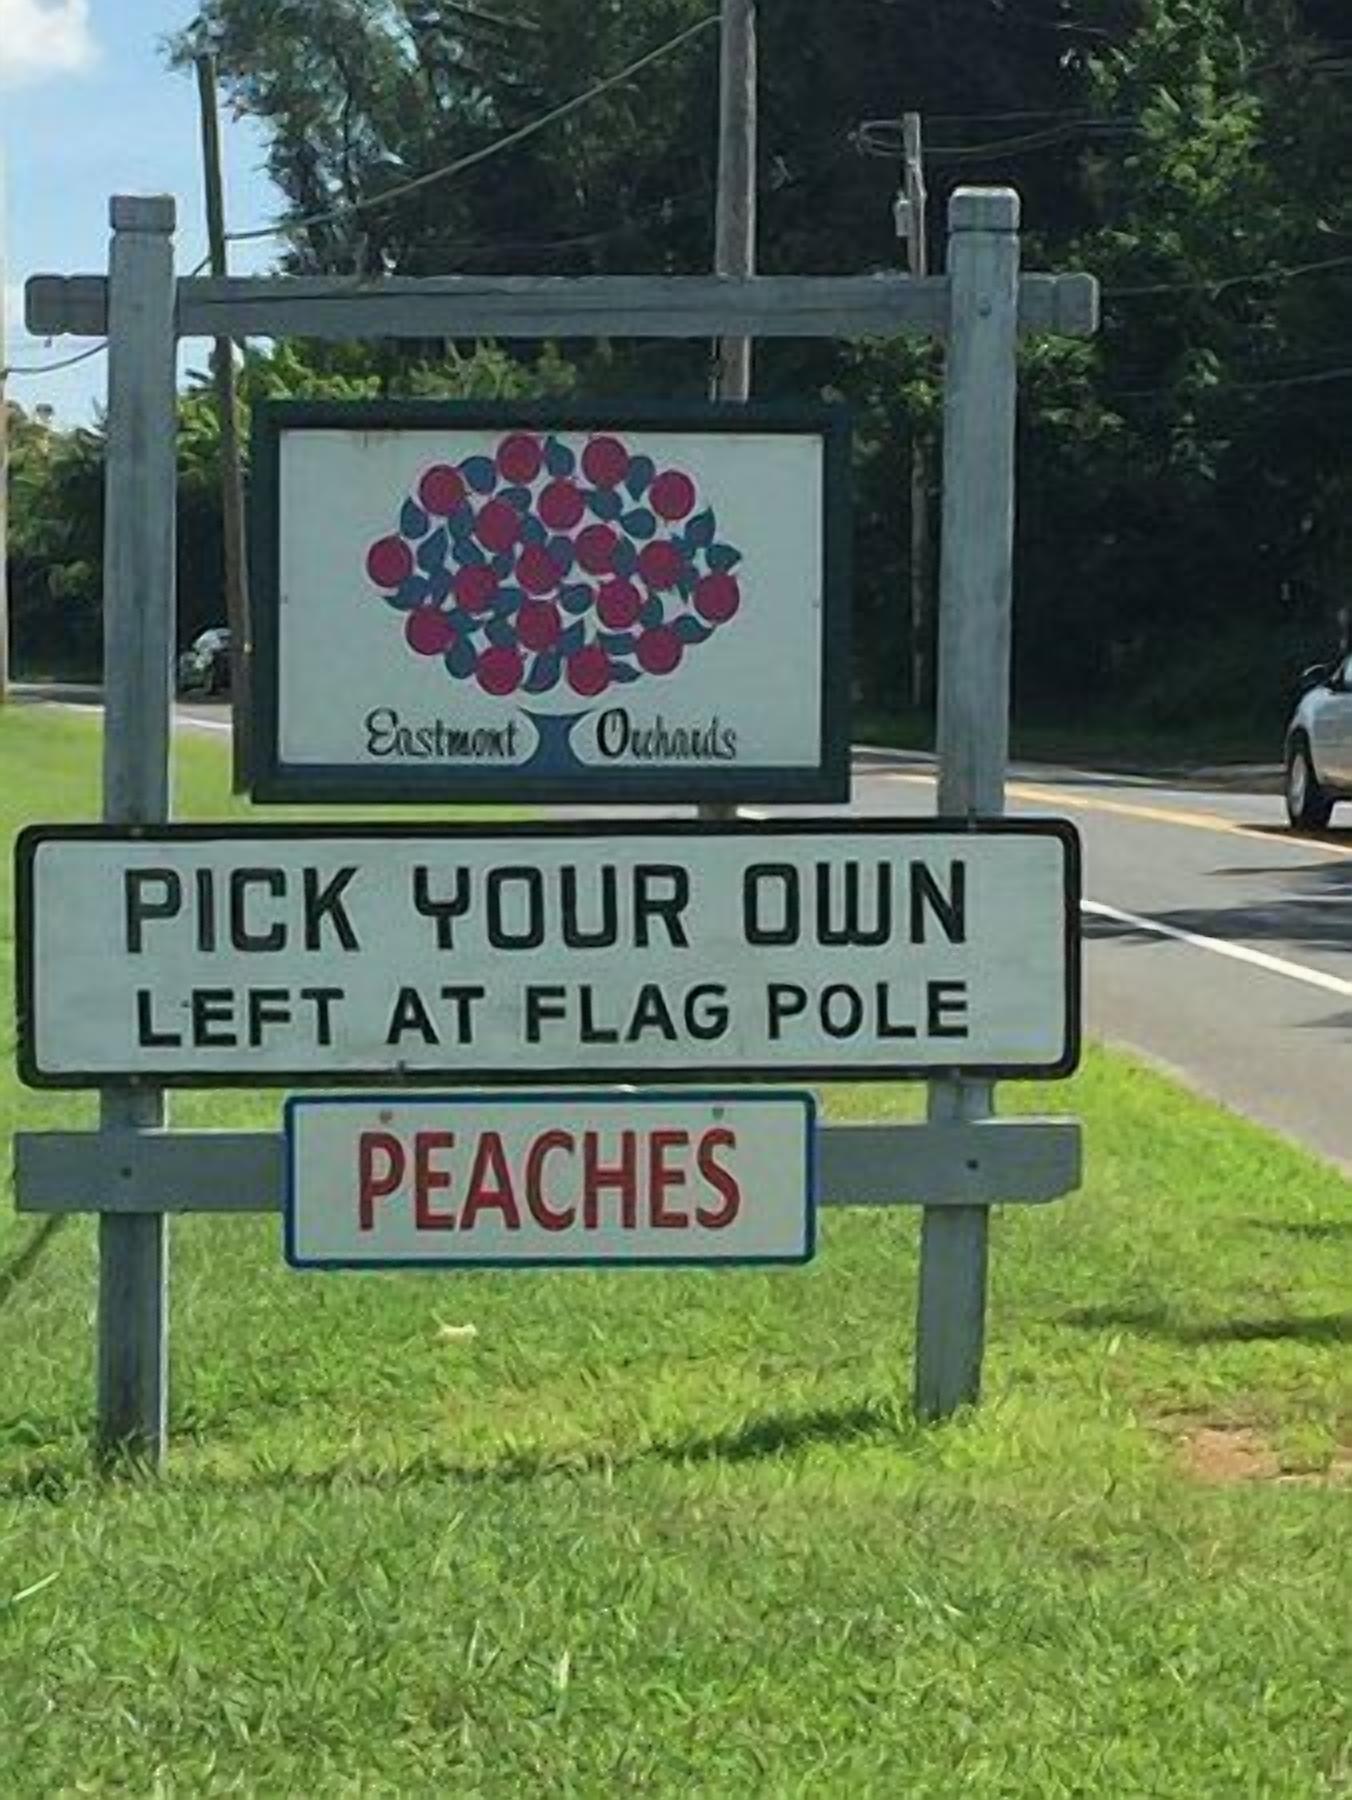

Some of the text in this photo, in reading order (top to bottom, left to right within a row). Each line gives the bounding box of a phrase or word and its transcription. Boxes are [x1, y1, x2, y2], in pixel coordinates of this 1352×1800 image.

[595, 706, 738, 761] Orchards
[124, 859, 967, 955] PICK YOUR OWN
[136, 980, 969, 1048] LEFT AT FLAG POLE
[358, 1127, 741, 1232] PEACHES
